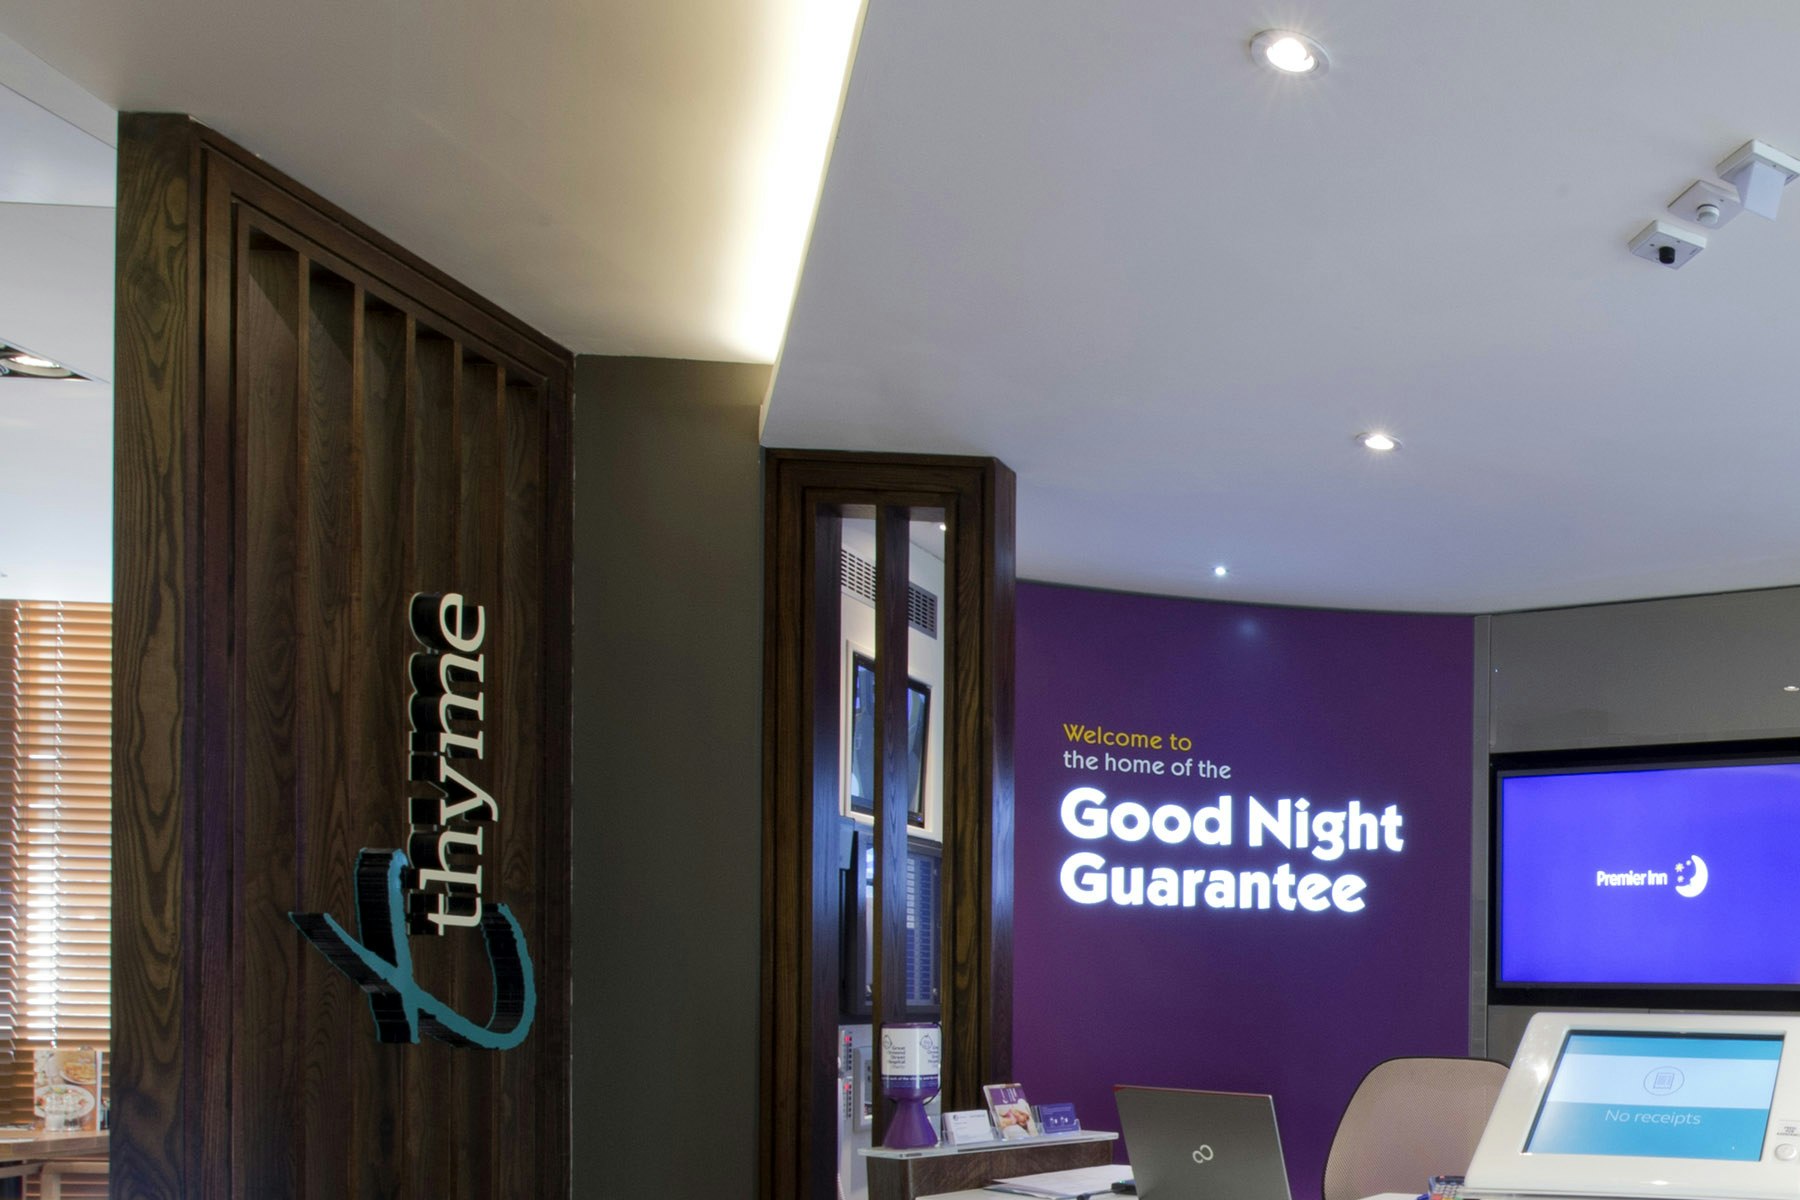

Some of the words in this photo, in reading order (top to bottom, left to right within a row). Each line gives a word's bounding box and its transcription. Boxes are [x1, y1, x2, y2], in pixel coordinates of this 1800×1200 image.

[1063, 723, 1162, 750] Welcome
[1169, 733, 1192, 751] to
[417, 593, 498, 936] thyme
[1063, 750, 1099, 770] the
[1105, 752, 1165, 775] home
[1171, 758, 1193, 776] of
[1198, 760, 1232, 779] the
[1060, 786, 1232, 847] Good
[1249, 796, 1404, 861] Night
[1060, 852, 1367, 913] Guarantee
[1596, 869, 1646, 887] Premier
[1647, 869, 1668, 886] Inn
[1604, 1109, 1630, 1123] No
[1634, 1111, 1702, 1127] receipts
